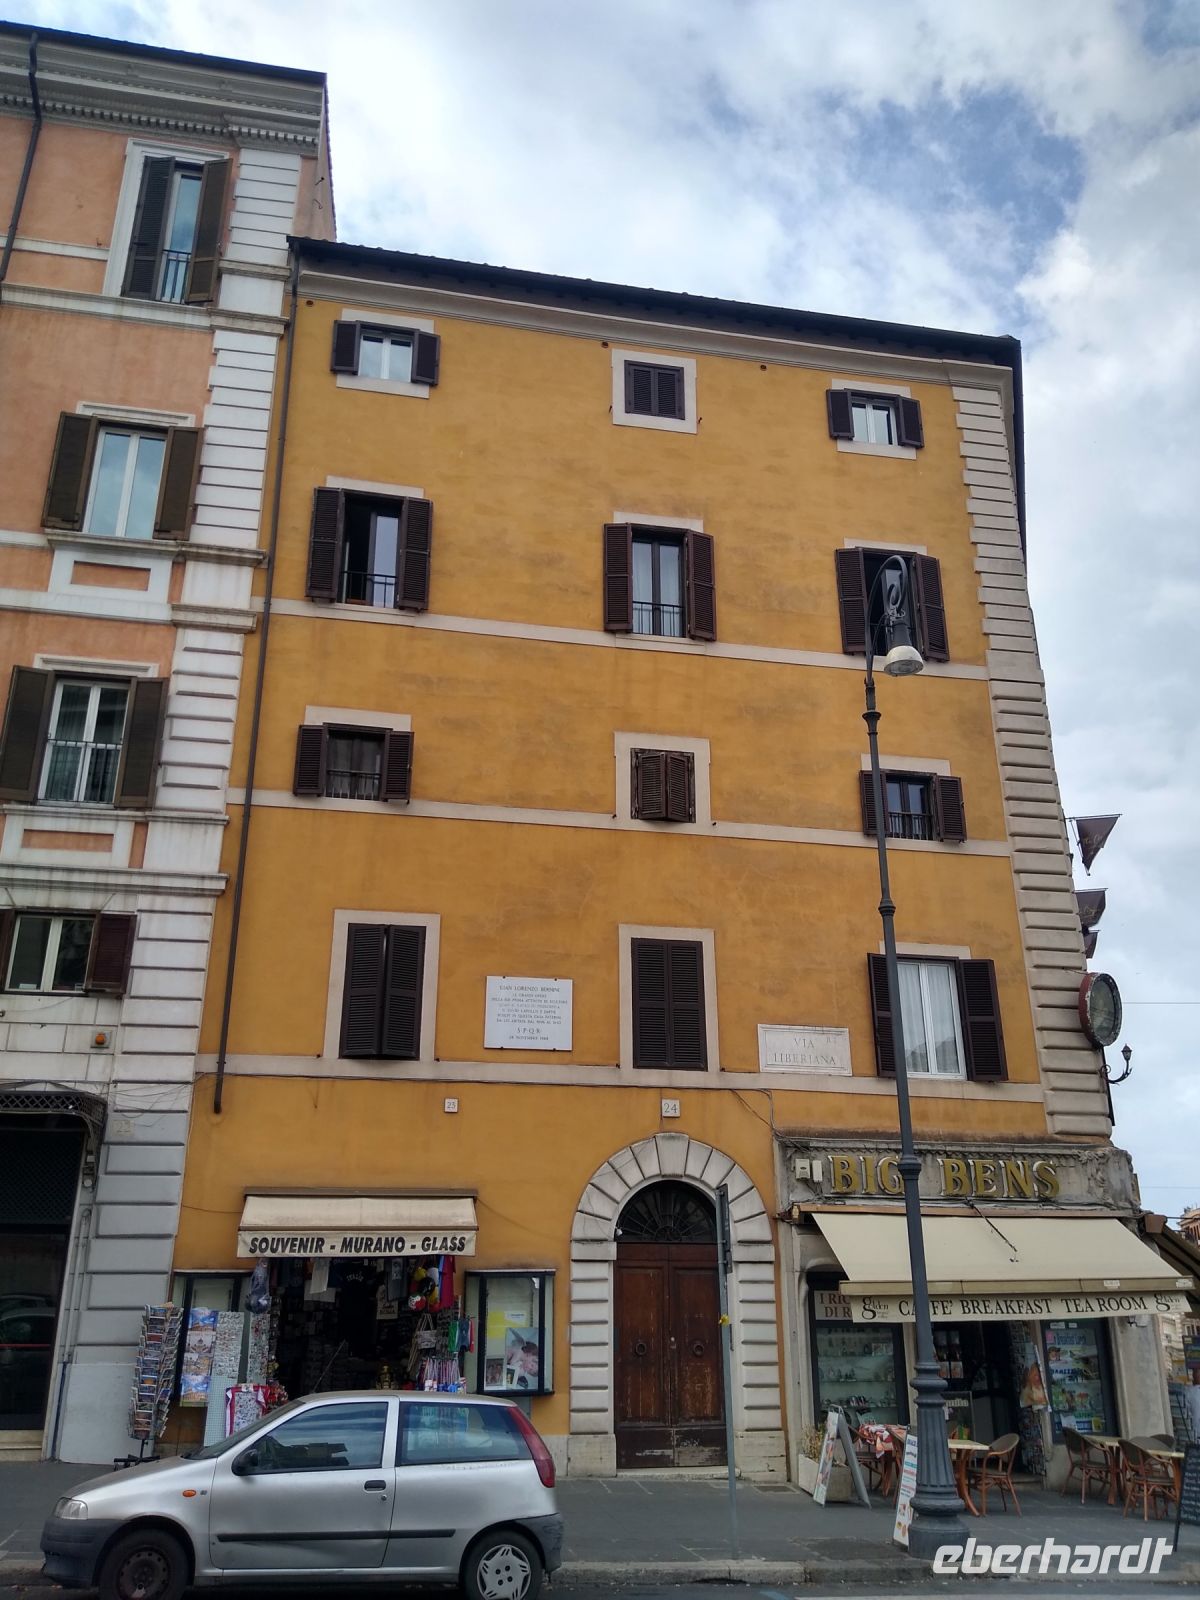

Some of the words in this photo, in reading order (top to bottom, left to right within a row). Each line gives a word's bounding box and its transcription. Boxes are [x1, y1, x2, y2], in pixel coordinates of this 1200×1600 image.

[794, 1038, 815, 1049] VIA
[774, 1052, 836, 1065] LIBERIANA
[664, 1102, 678, 1113] 24
[828, 1155, 905, 1195] BIG
[938, 1158, 1060, 1198] BENS
[249, 1237, 325, 1254] SOUVENIR
[340, 1236, 406, 1253] MURANO
[421, 1236, 466, 1252] GLASS
[824, 1306, 838, 1318] DI
[898, 1299, 953, 1316] CFE'
[960, 1298, 1052, 1315] BREAKFAST
[1061, 1297, 1095, 1313] TEA
[1096, 1296, 1148, 1312] ROOM
